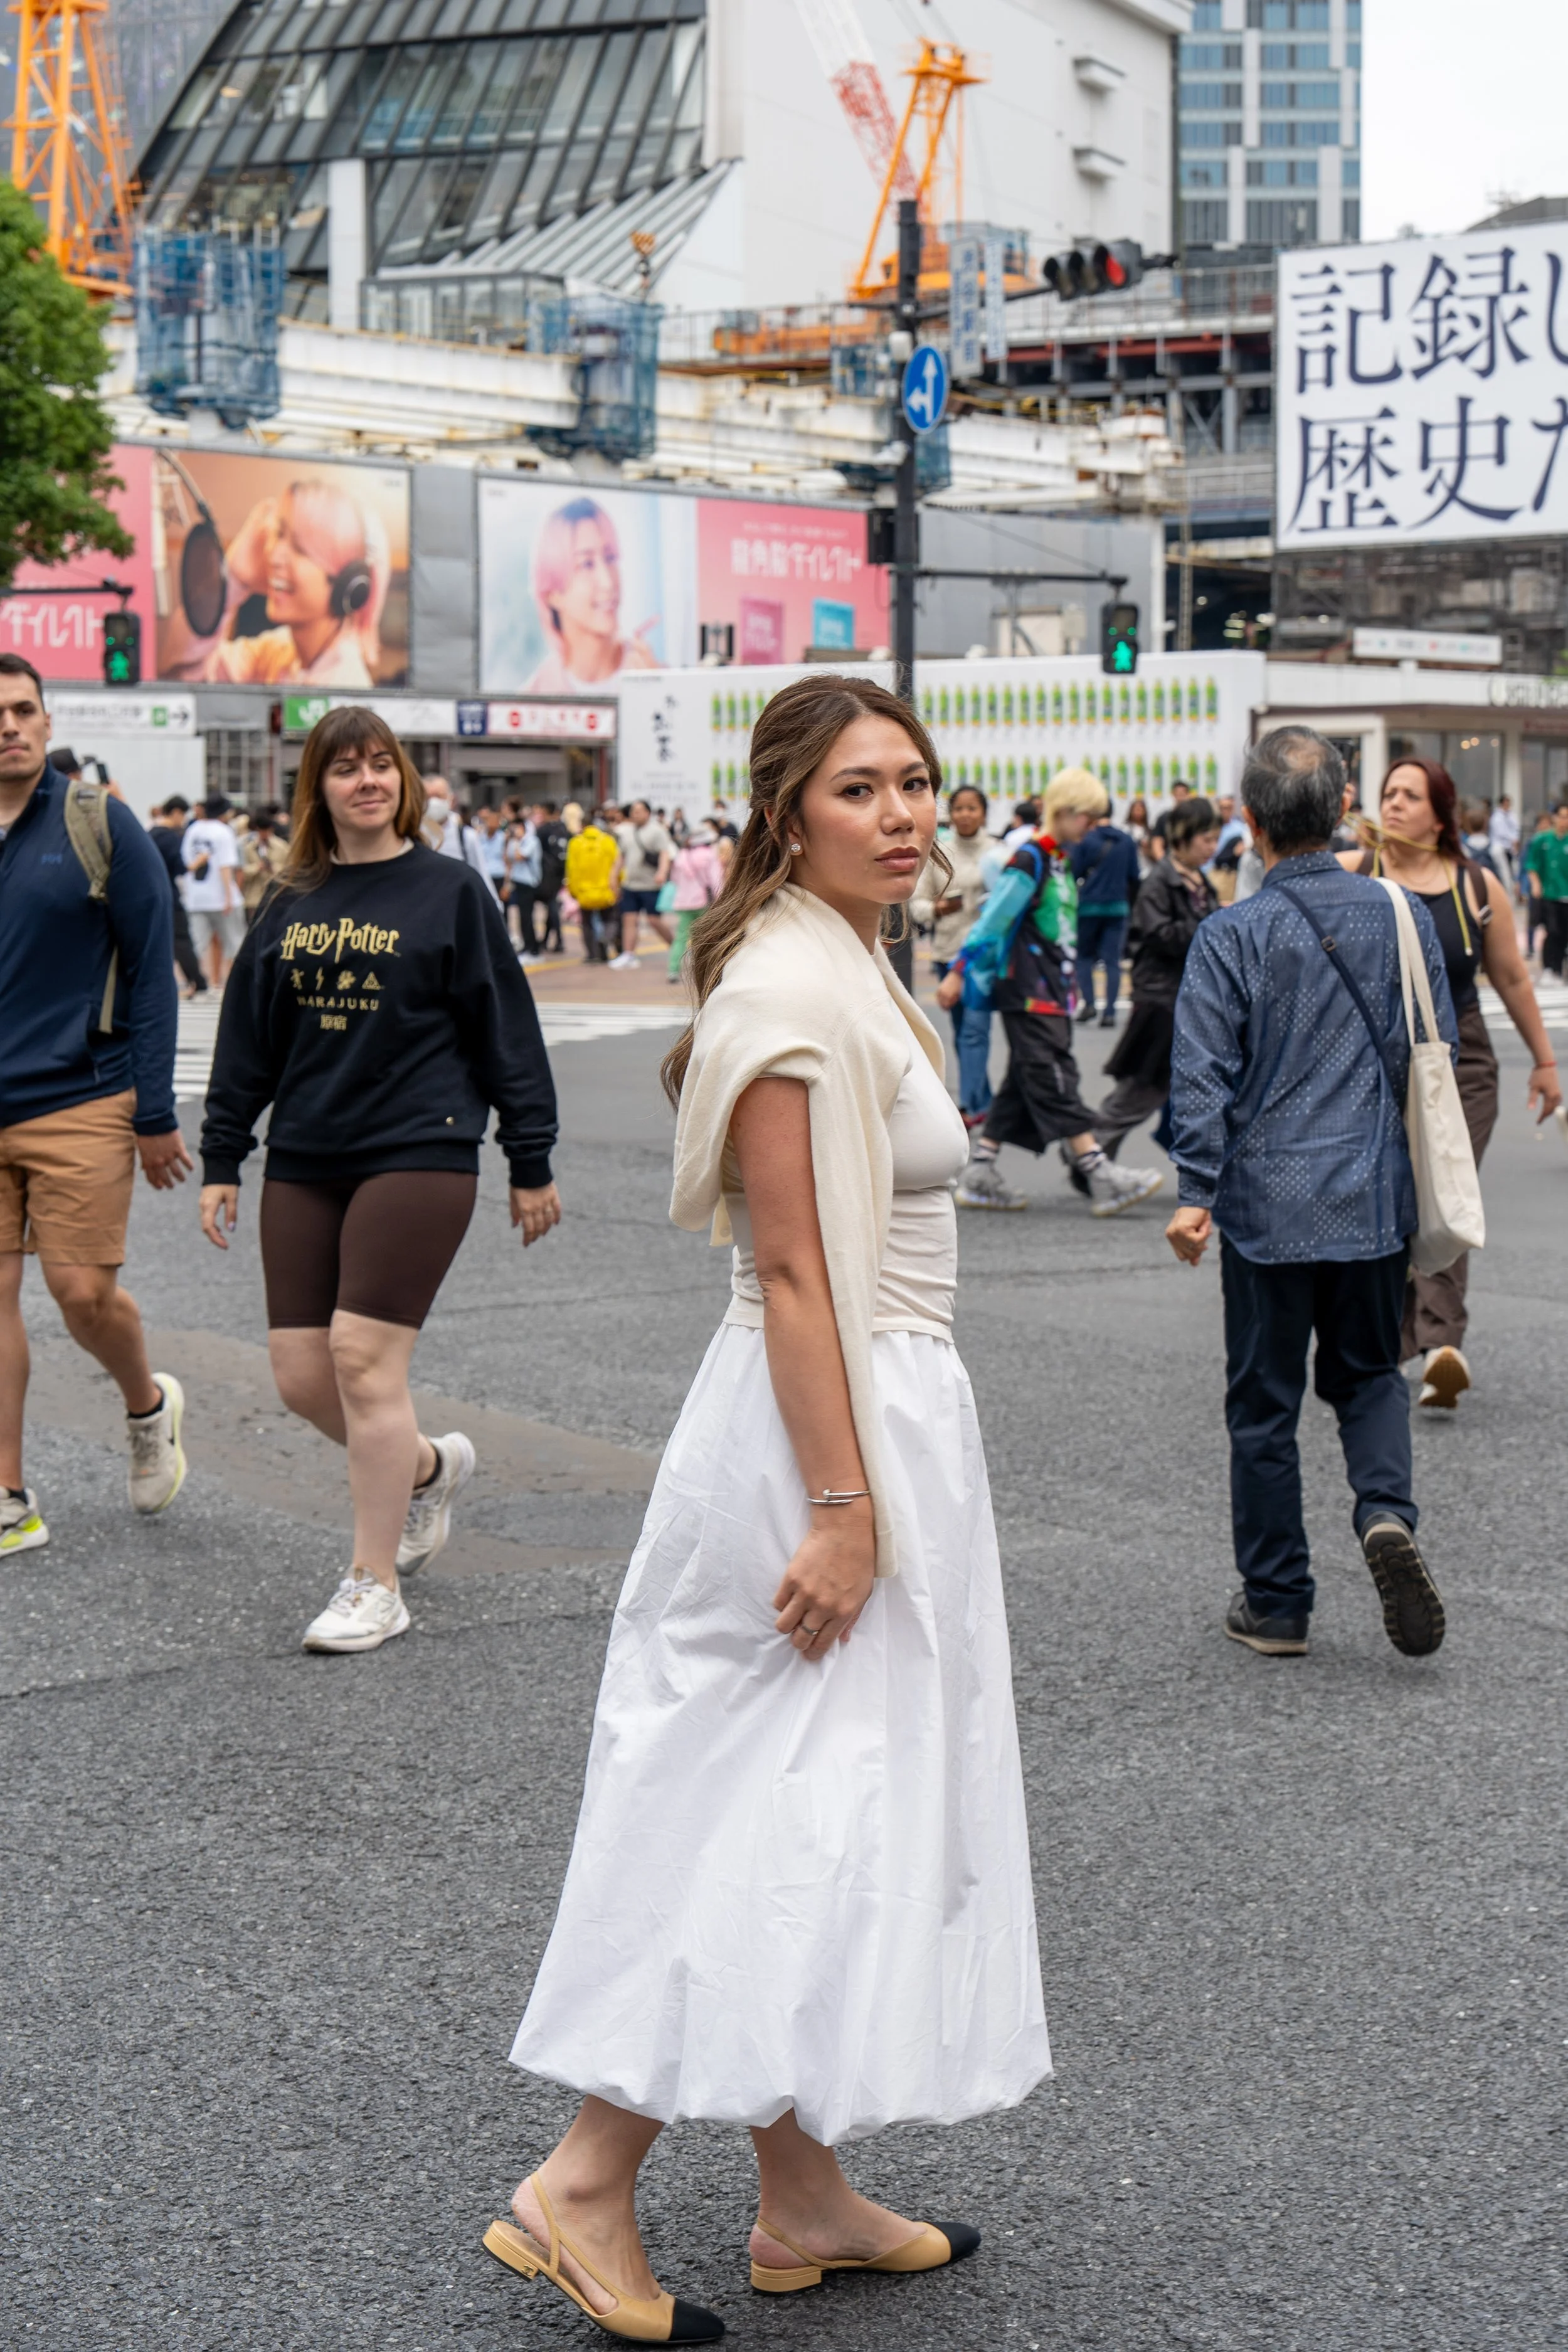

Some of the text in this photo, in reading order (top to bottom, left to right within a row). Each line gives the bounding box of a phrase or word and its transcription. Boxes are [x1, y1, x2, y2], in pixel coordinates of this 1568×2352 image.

[1290, 247, 1568, 394] 記録し
[280, 918, 400, 963] Harry Potter
[297, 995, 379, 1011] HARAJUKU
[320, 1014, 347, 1030] 原宿
